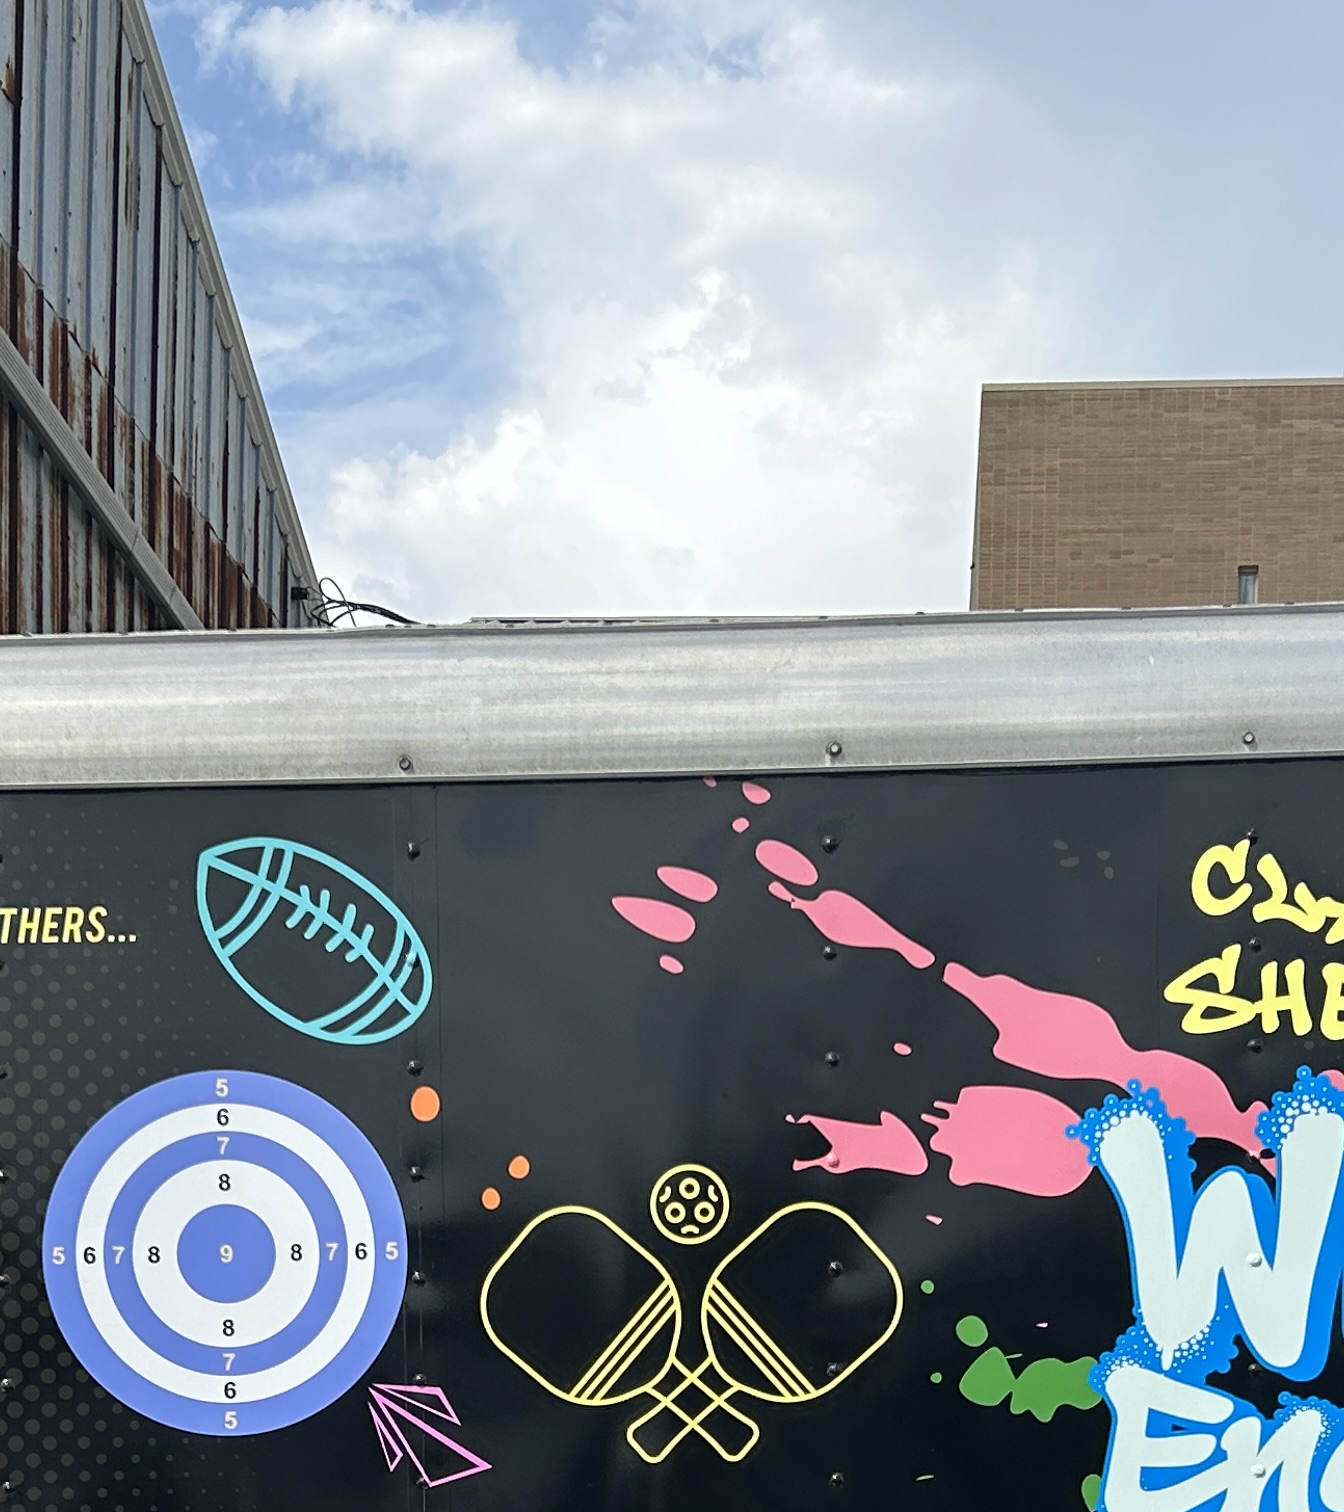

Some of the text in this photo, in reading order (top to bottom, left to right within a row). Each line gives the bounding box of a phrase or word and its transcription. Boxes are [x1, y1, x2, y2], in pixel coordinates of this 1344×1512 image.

[214, 1078, 229, 1097] 5
[216, 1108, 229, 1127] 6
[217, 1136, 230, 1155] 7
[218, 1173, 231, 1192] 8
[51, 1241, 399, 1265] 5 6 7 8 9 8 7 6 5
[222, 1319, 235, 1337] 8
[222, 1353, 236, 1371] 7
[223, 1381, 237, 1399] 6
[224, 1411, 238, 1430] 5
